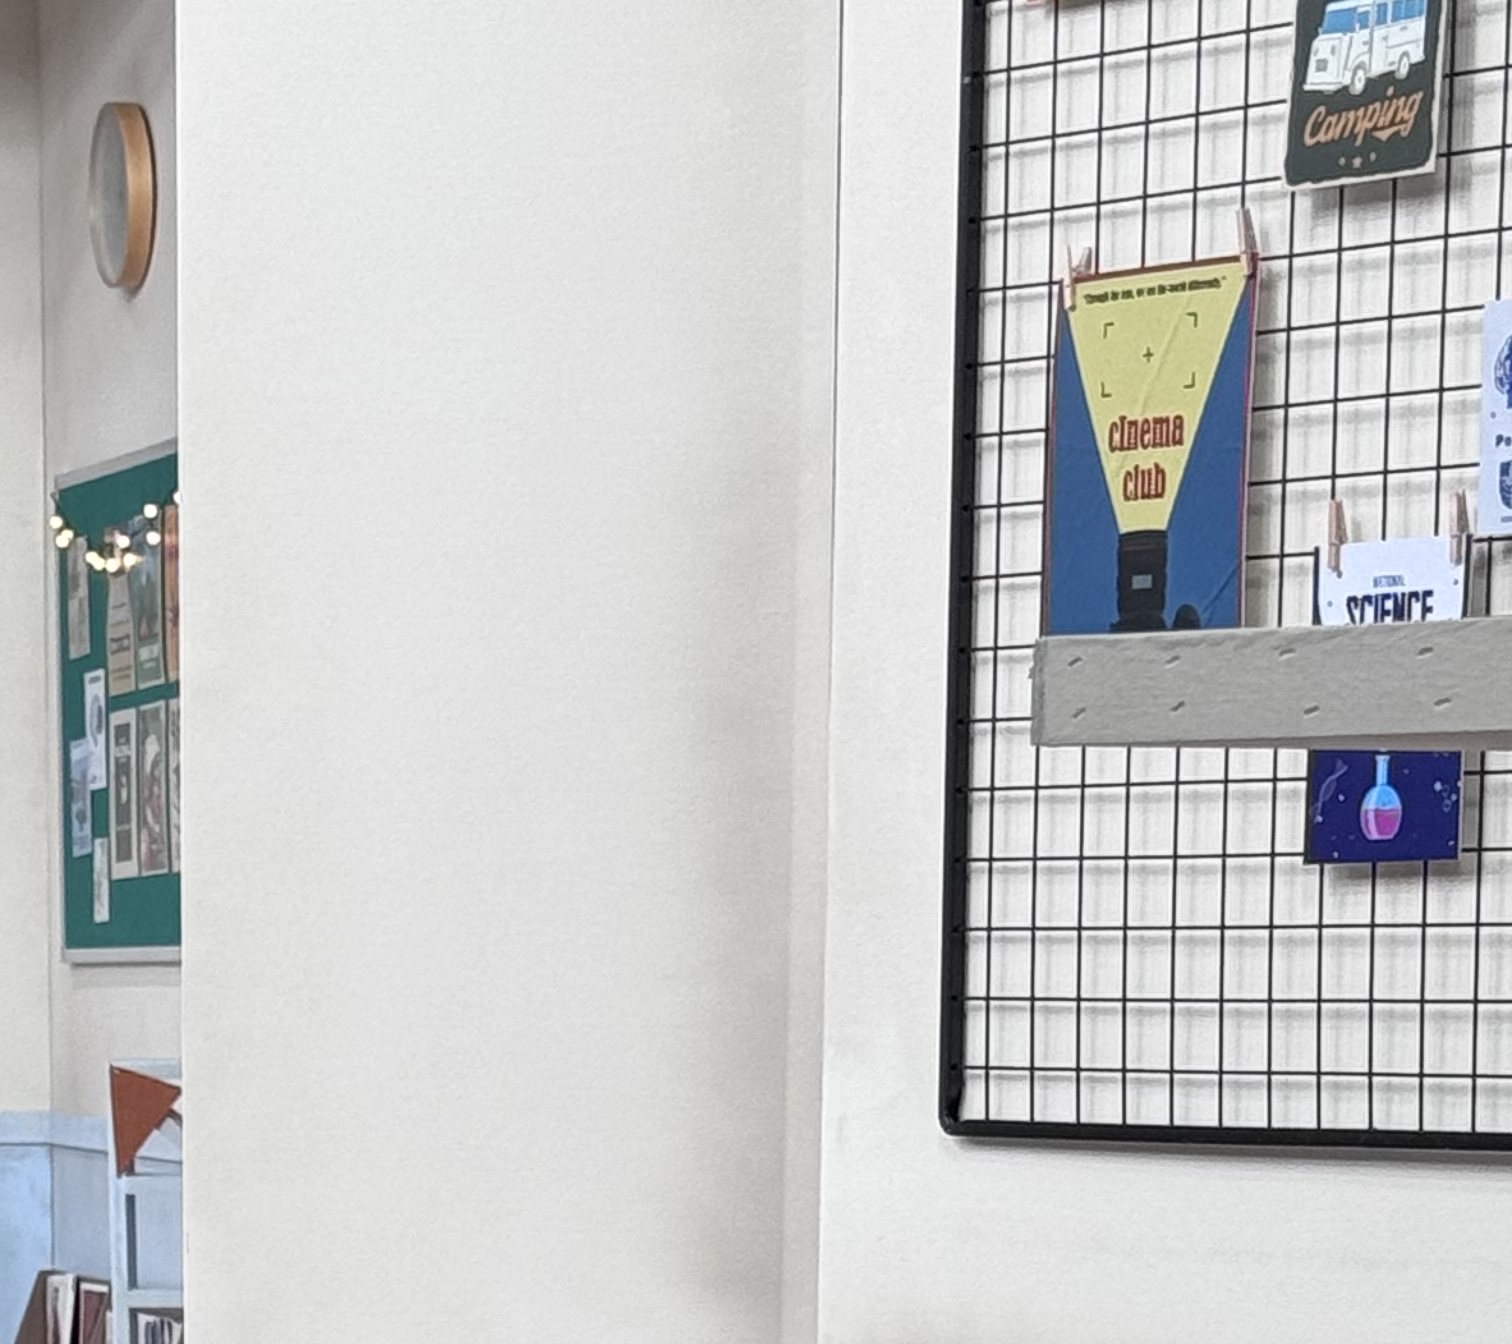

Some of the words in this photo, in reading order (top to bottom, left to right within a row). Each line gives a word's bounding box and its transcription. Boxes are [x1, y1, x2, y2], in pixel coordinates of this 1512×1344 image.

[1304, 86, 1424, 147] Camping
[1108, 414, 1184, 454] cinema
[1122, 461, 1167, 502] club
[1346, 589, 1434, 626] SCIENCE
